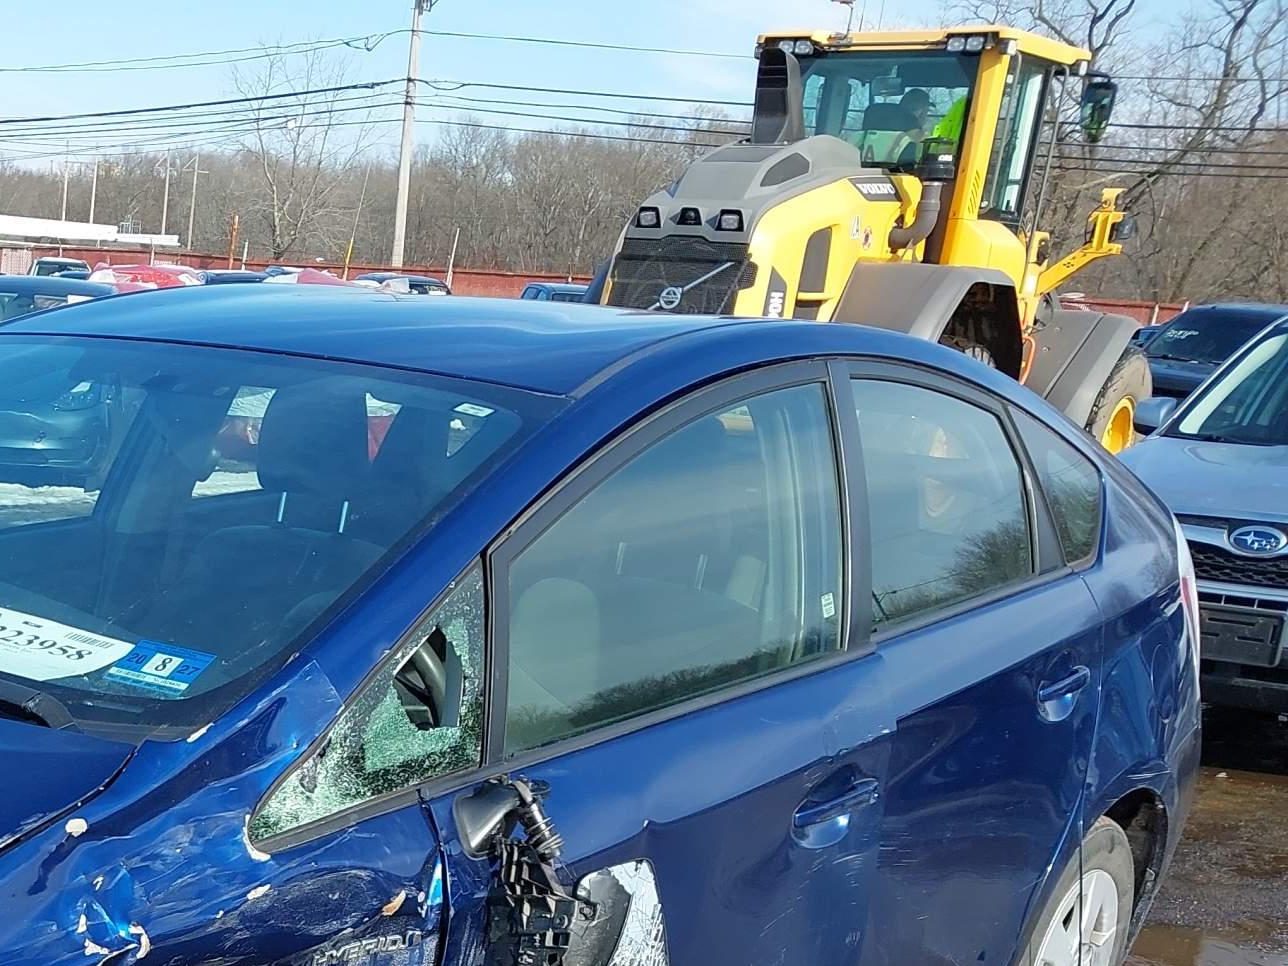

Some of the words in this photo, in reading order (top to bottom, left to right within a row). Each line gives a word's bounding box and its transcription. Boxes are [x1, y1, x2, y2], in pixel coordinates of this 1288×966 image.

[855, 183, 896, 194] VOLVO
[128, 652, 148, 665] 20
[154, 657, 173, 672] 8
[176, 664, 201, 676] 27
